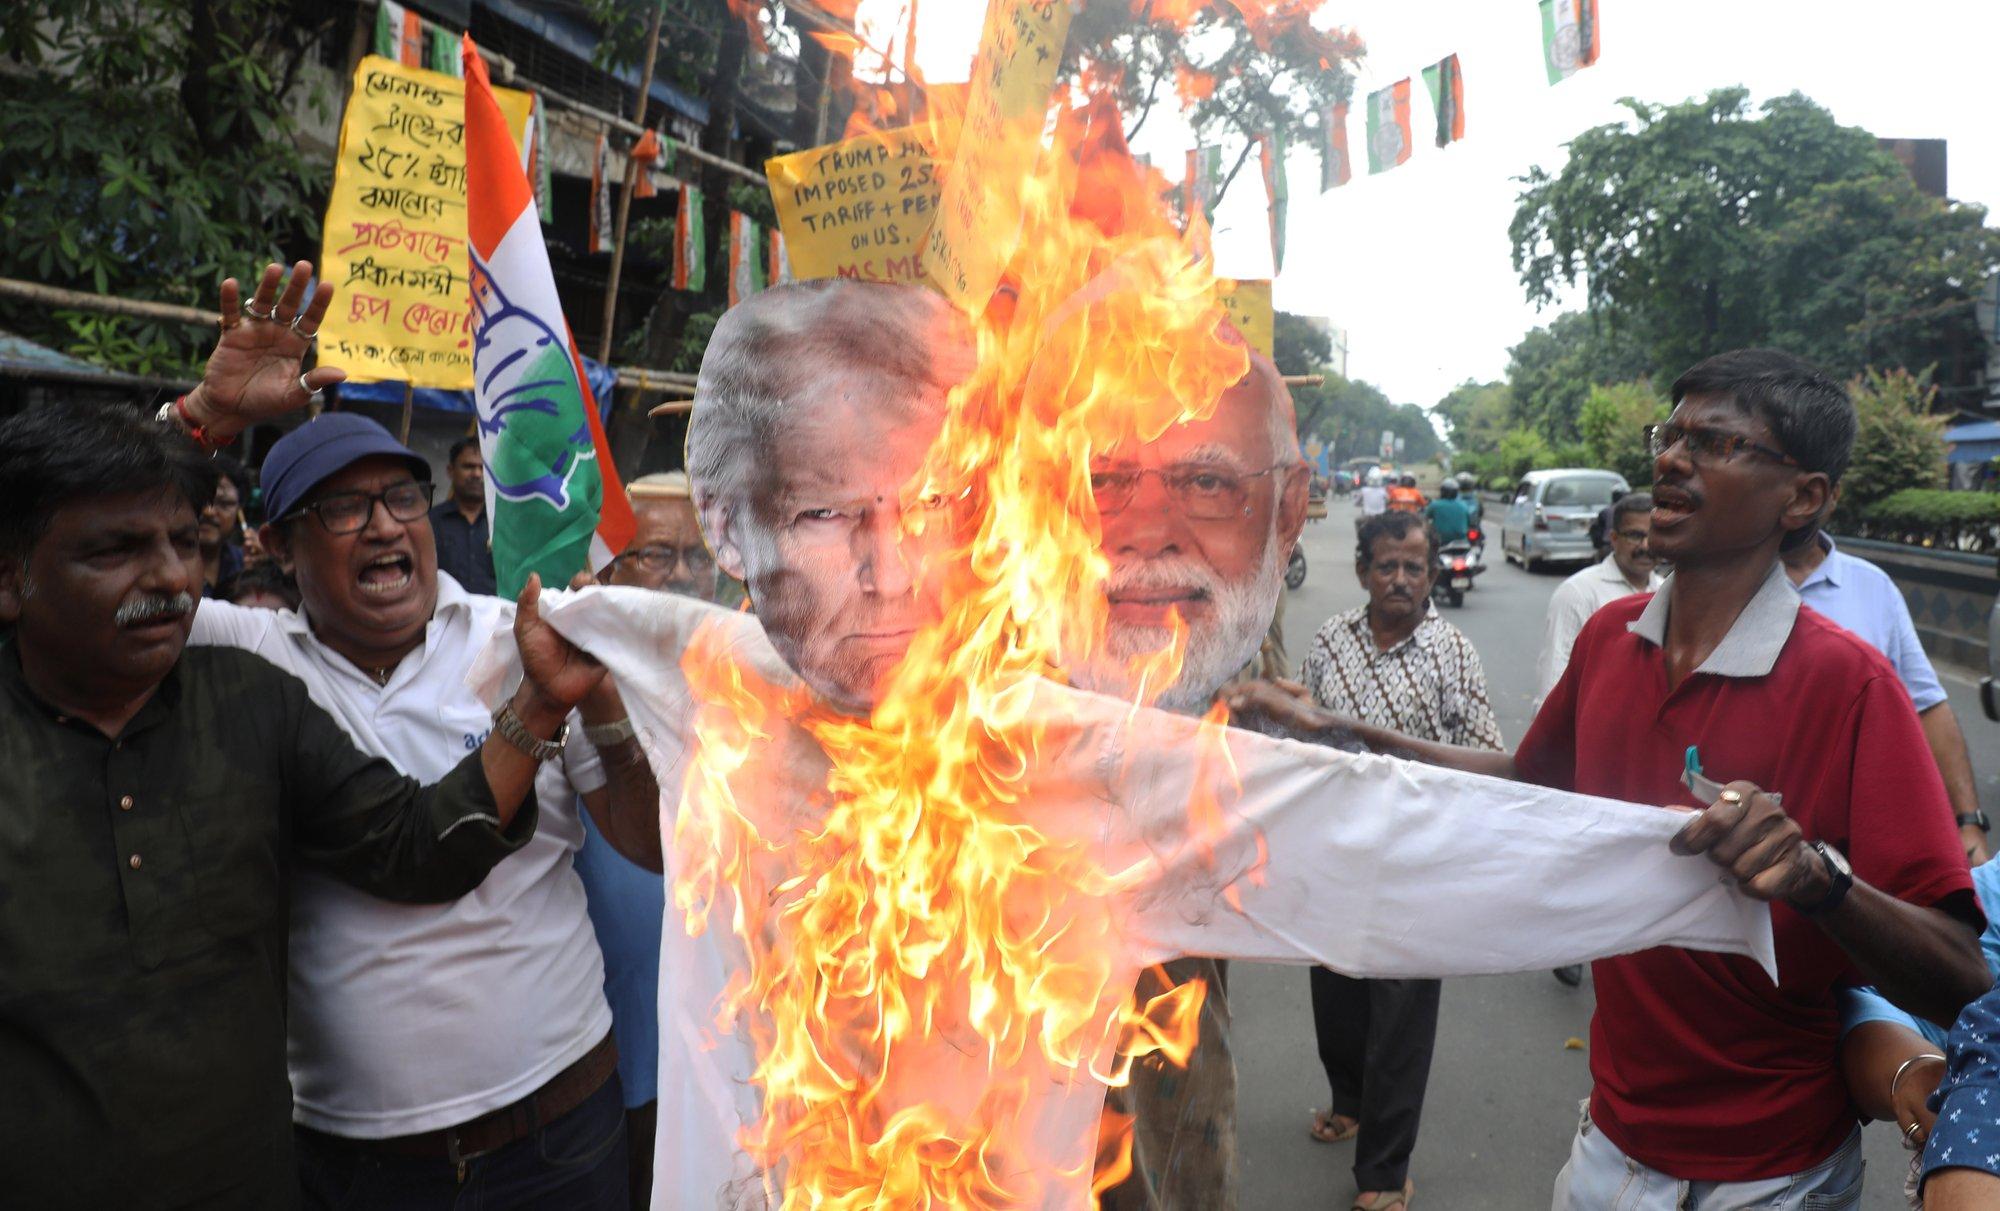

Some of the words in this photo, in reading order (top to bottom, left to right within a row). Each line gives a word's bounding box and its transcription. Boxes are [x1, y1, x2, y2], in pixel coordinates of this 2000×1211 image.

[365, 71, 464, 106] ডোনাল্ড
[358, 138, 421, 179] ২৫%
[817, 144, 889, 175] TRUMP
[794, 171, 886, 207] IMPOSED
[899, 164, 938, 194] 25
[801, 200, 876, 234] TARIFF
[880, 201, 897, 218] +
[902, 193, 942, 216] PEN
[338, 220, 464, 263] প্রতিবাদে
[851, 233, 869, 250] ON
[349, 294, 391, 325] চুপ
